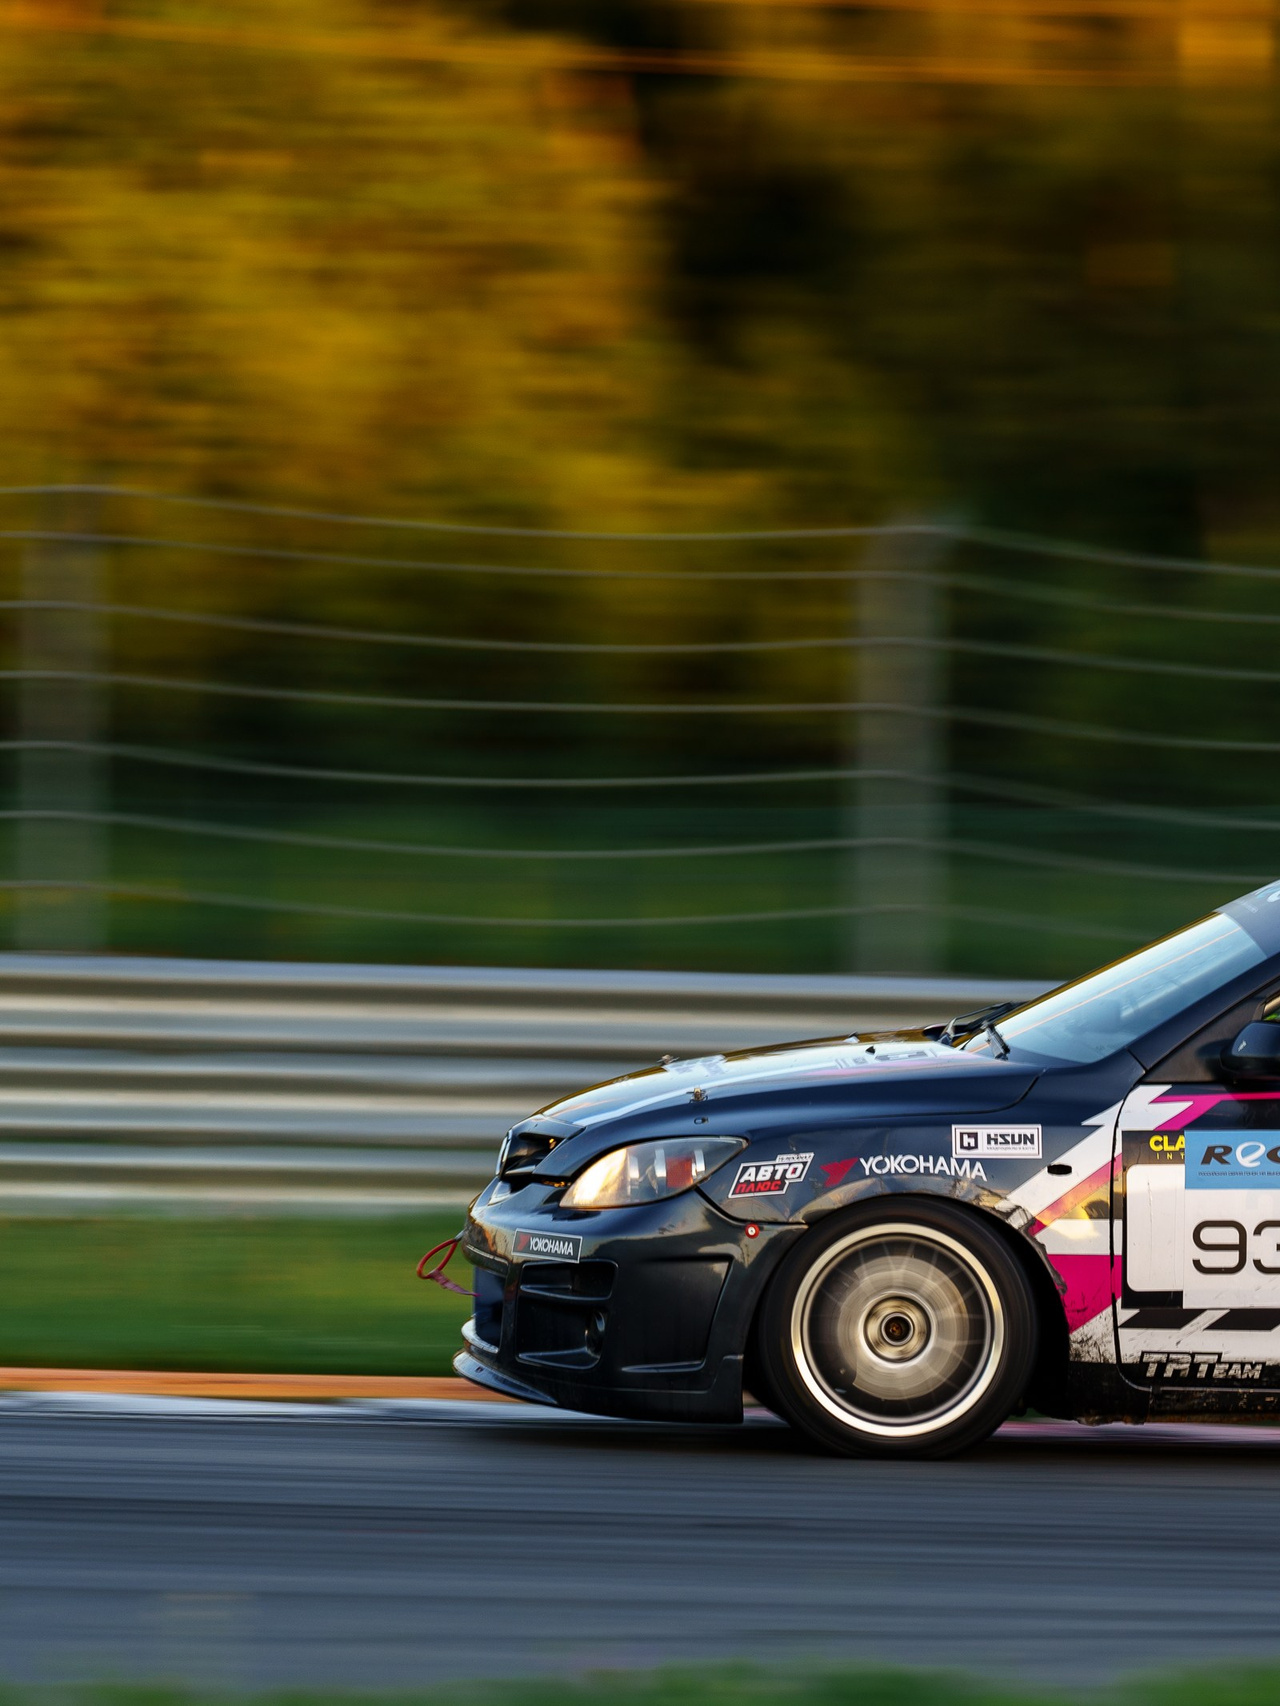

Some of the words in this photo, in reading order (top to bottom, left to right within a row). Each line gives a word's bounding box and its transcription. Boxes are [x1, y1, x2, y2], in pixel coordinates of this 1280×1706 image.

[739, 1162, 804, 1183] АВТО
[859, 1154, 988, 1182] YOKOHAMA
[734, 1180, 782, 1194] ПЛЮС
[529, 1236, 574, 1256] YOKOHAMA
